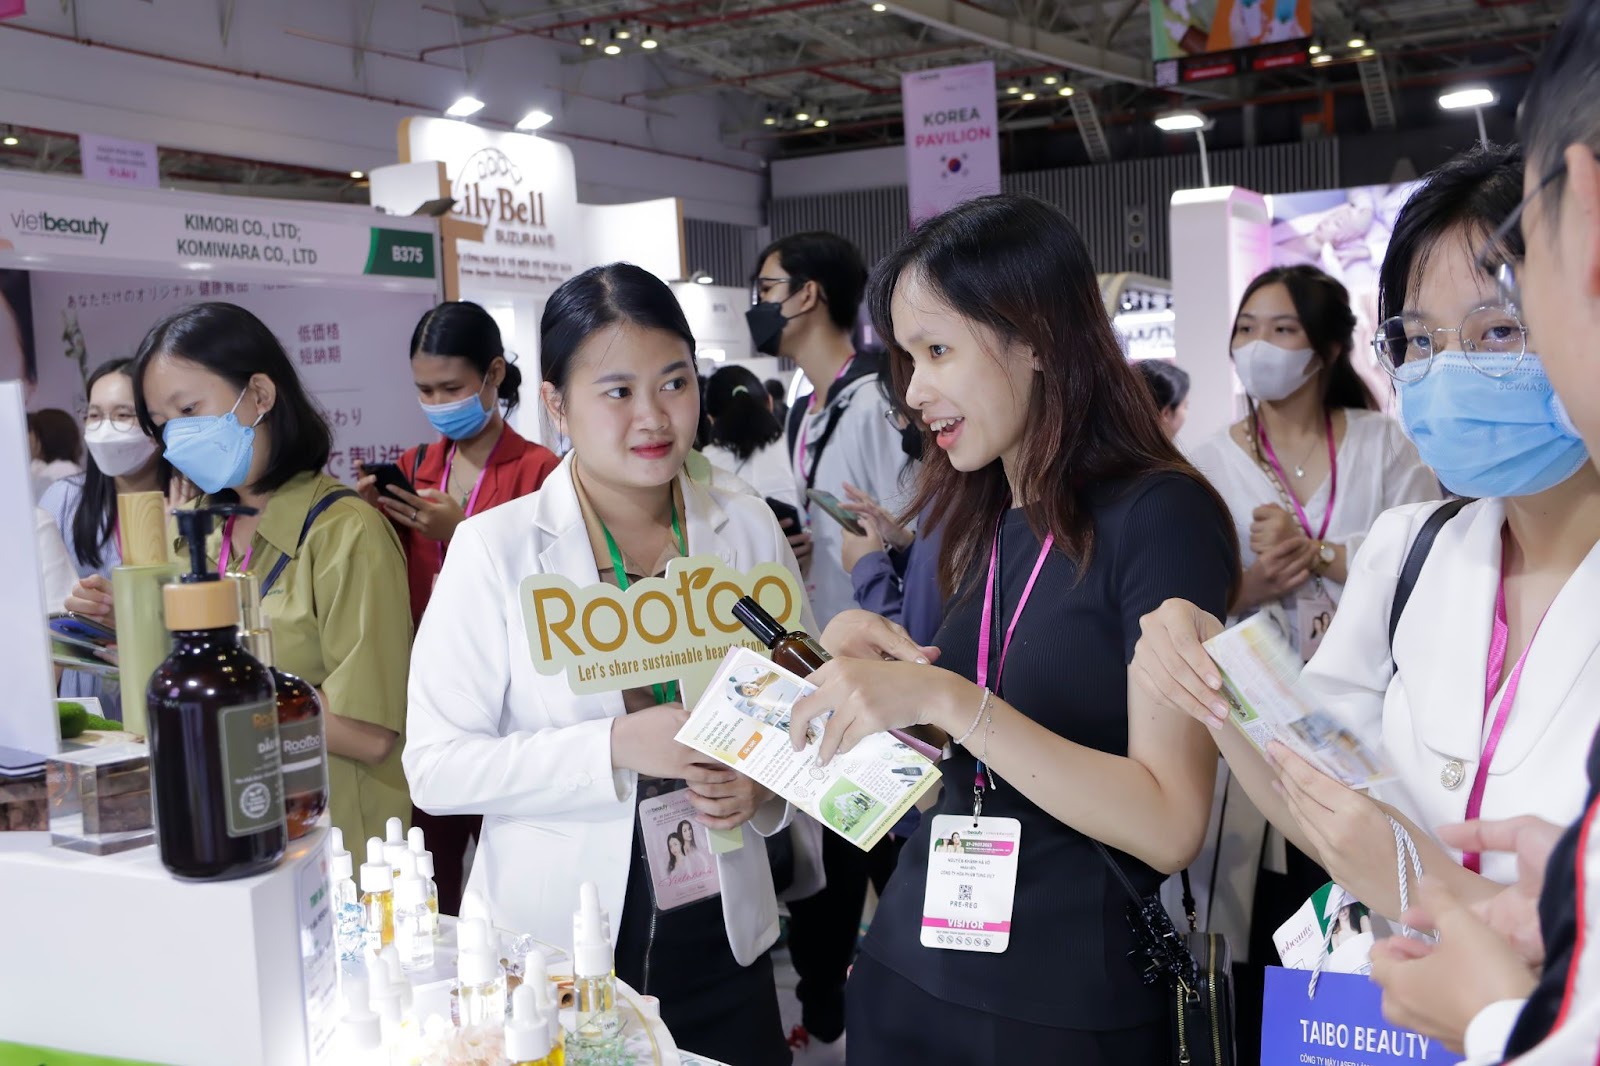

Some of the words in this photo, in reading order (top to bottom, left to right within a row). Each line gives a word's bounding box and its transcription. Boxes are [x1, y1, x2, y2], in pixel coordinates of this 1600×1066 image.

[923, 107, 981, 126] KOREA
[915, 126, 991, 147] PAVILION
[11, 209, 109, 244] vietbeauty
[185, 213, 239, 234] KIMORI
[242, 220, 269, 239] CO.,
[272, 222, 301, 242] LTD;
[177, 239, 260, 261] KOMIWARA
[263, 246, 291, 266] CO.,
[293, 248, 317, 265] LTD
[392, 245, 423, 264] B375
[298, 323, 340, 343] 低価格
[299, 346, 341, 366] 短納期
[533, 567, 793, 661] Rootoo
[578, 661, 606, 682] Let's
[609, 659, 639, 677] share
[642, 648, 702, 671] sustainable
[706, 645, 738, 660] beaut
[741, 639, 766, 653] from
[949, 900, 978, 909] PRE-REG
[947, 918, 985, 930] VISITOR
[1300, 1019, 1350, 1048] TAIBO
[1354, 1026, 1430, 1060] BEAUTY
[1317, 1056, 1324, 1065] TY
